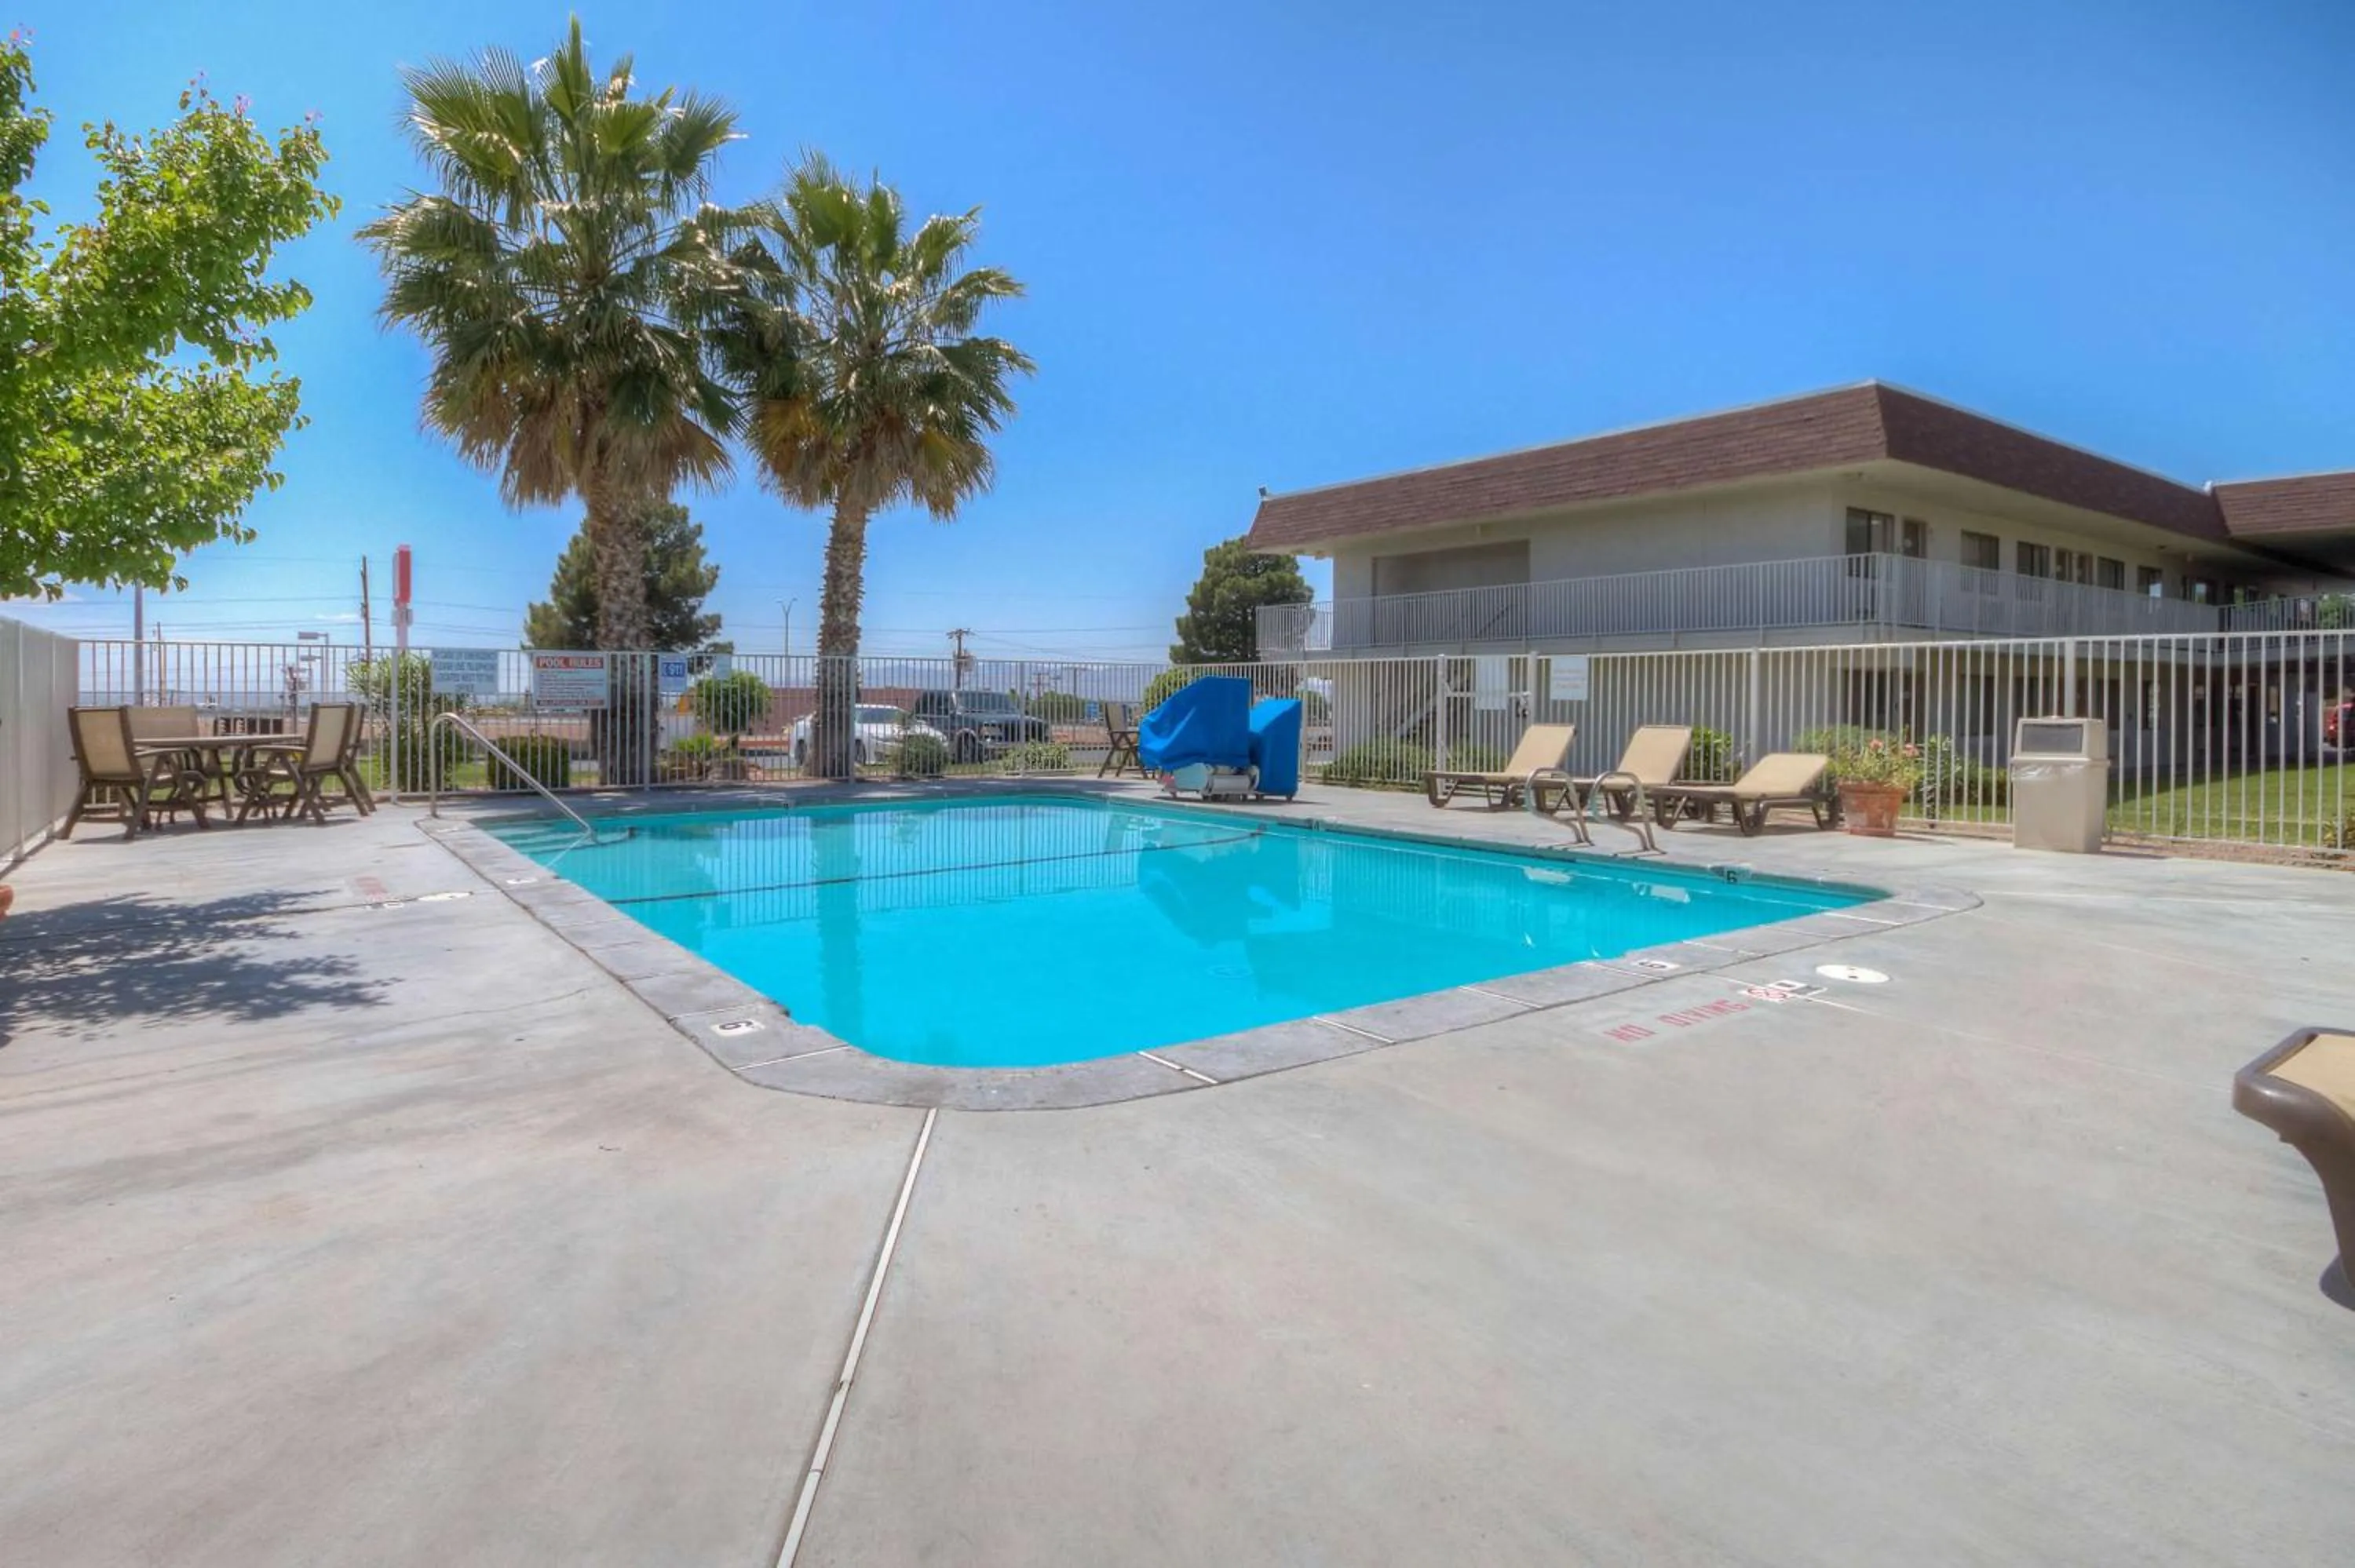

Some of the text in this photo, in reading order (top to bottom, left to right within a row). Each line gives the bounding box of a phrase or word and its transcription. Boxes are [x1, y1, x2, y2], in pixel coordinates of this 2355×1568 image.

[539, 658, 602, 668] POOL RULES
[1603, 1023, 1657, 1043] NO
